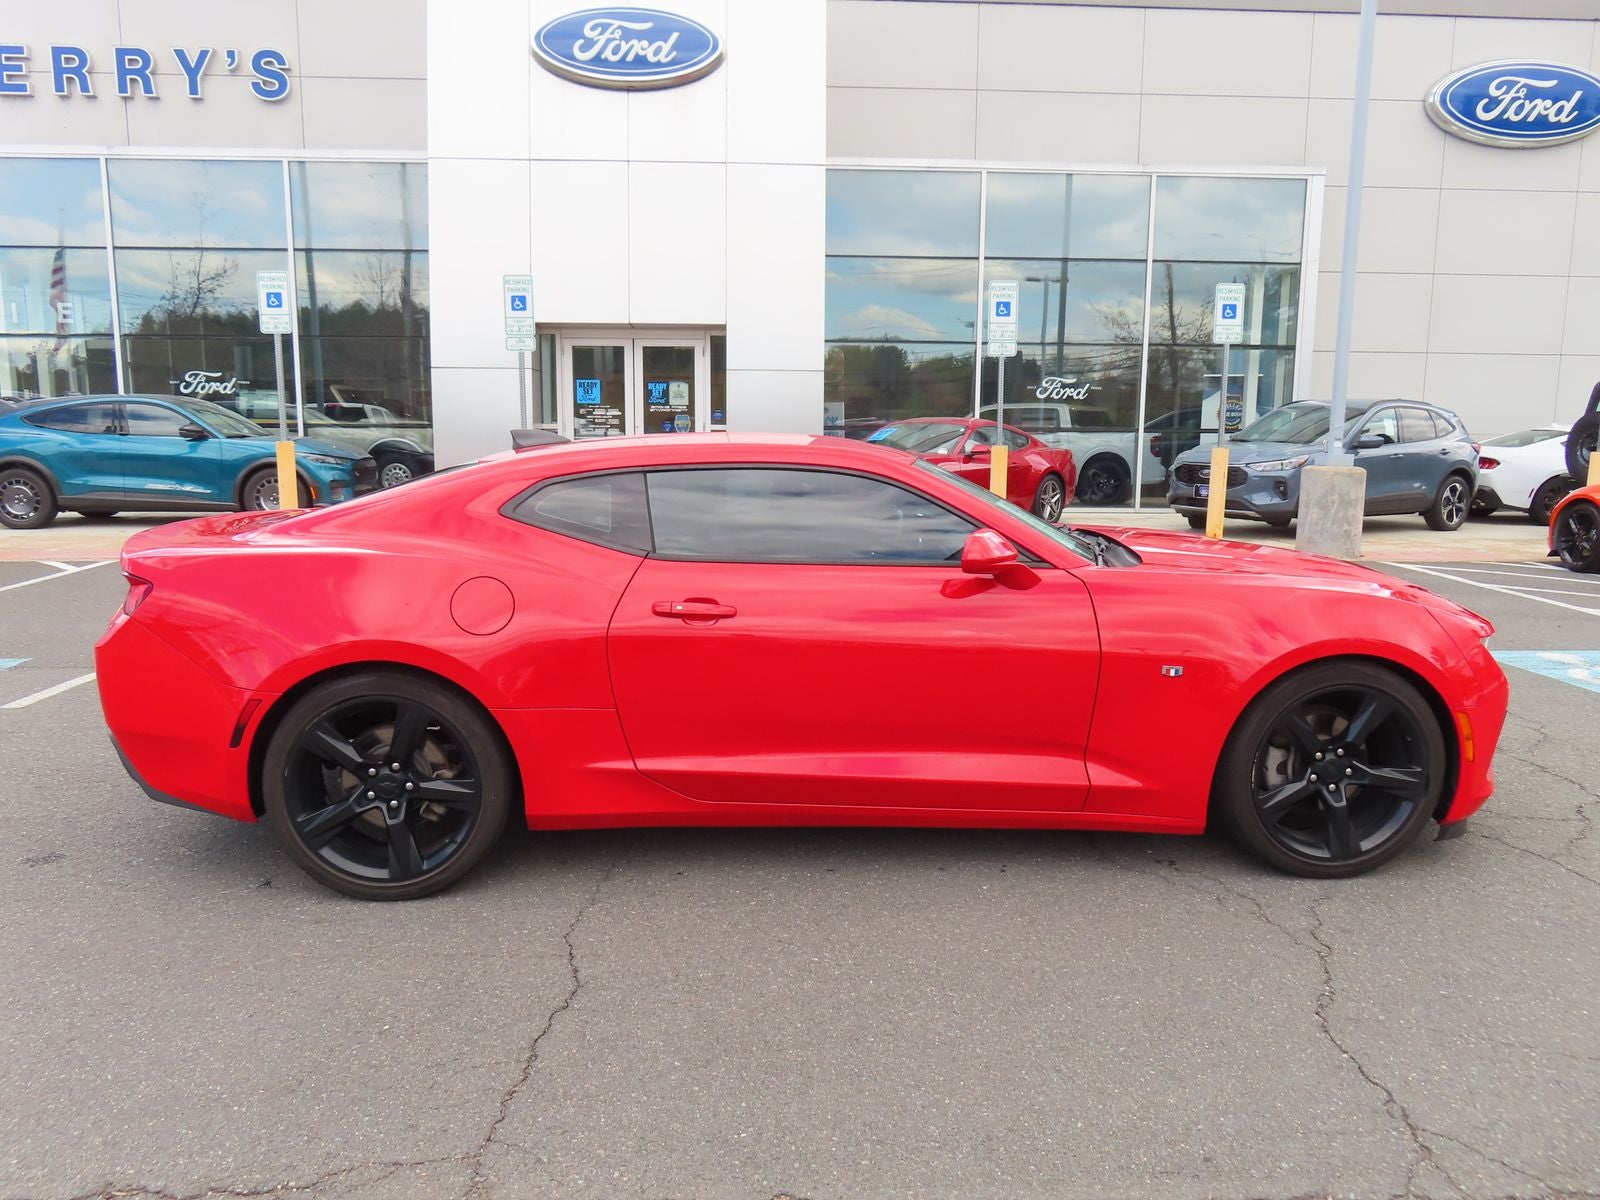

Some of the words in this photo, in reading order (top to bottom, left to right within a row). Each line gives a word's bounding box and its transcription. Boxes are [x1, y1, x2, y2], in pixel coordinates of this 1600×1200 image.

[573, 18, 681, 64] Ford
[1475, 76, 1584, 124] Ford
[180, 370, 237, 394] Ford
[578, 381, 598, 389] READY
[1036, 376, 1090, 400] Ford
